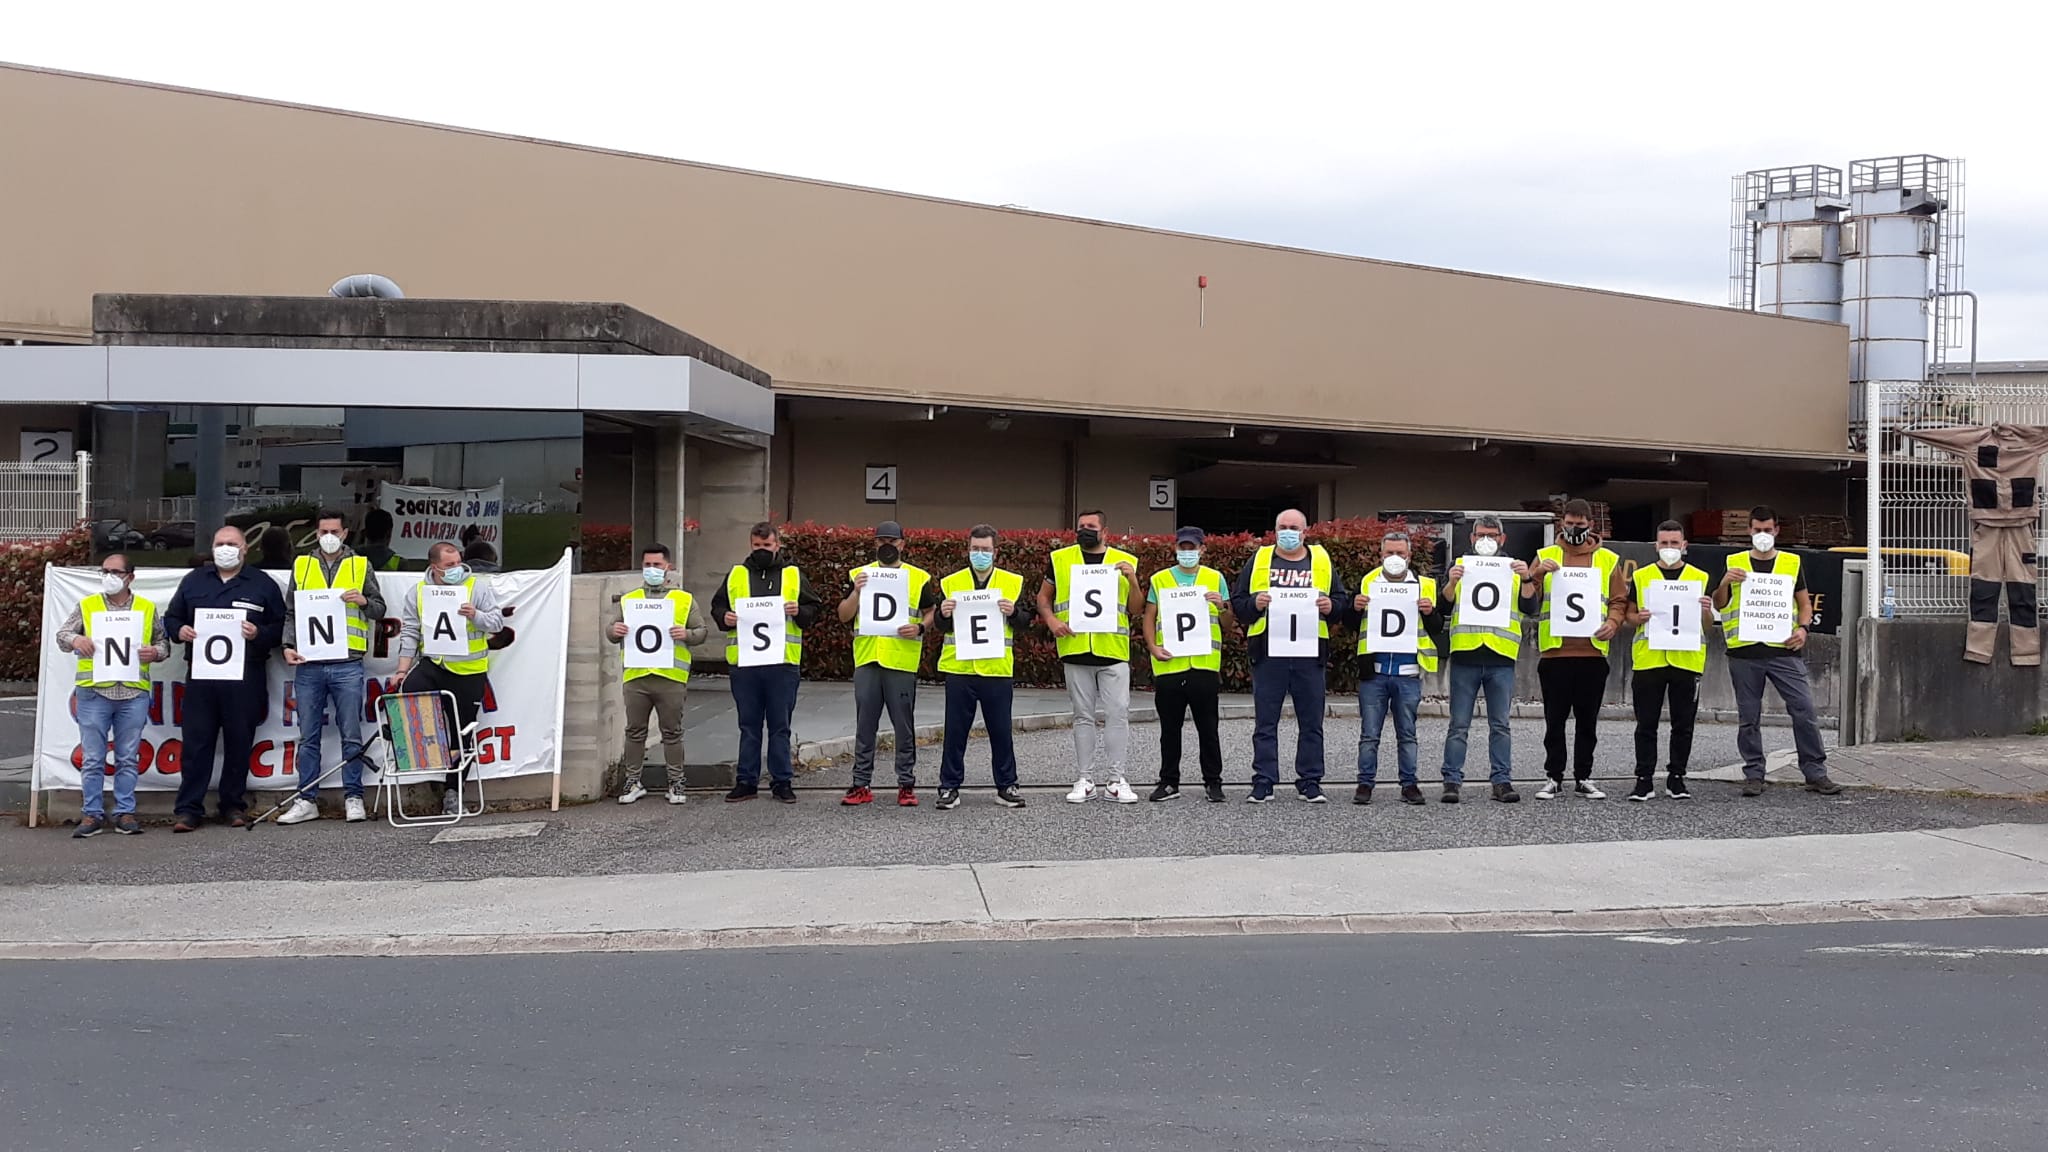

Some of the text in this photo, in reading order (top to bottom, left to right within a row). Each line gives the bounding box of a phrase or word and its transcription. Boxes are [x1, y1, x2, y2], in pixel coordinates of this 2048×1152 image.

[33, 438, 60, 464] 2
[871, 471, 892, 497] 4
[1155, 484, 1169, 505] 5
[1083, 589, 1103, 618] S
[1471, 582, 1500, 612] O
[1750, 588, 1772, 596] ANOS
[873, 592, 897, 622] D
[1565, 593, 1586, 623] S
[1672, 604, 1680, 636] !
[1743, 611, 1790, 620] TIRADOS AO
[308, 615, 334, 646] N
[433, 612, 457, 641] A
[753, 622, 771, 652] S
[970, 615, 989, 644] E
[1176, 613, 1196, 642] P
[1290, 613, 1297, 642] I
[1381, 608, 1406, 638] D
[1756, 623, 1774, 631] LIXO
[105, 637, 131, 666] N
[204, 634, 233, 666] O
[635, 624, 662, 654] O
